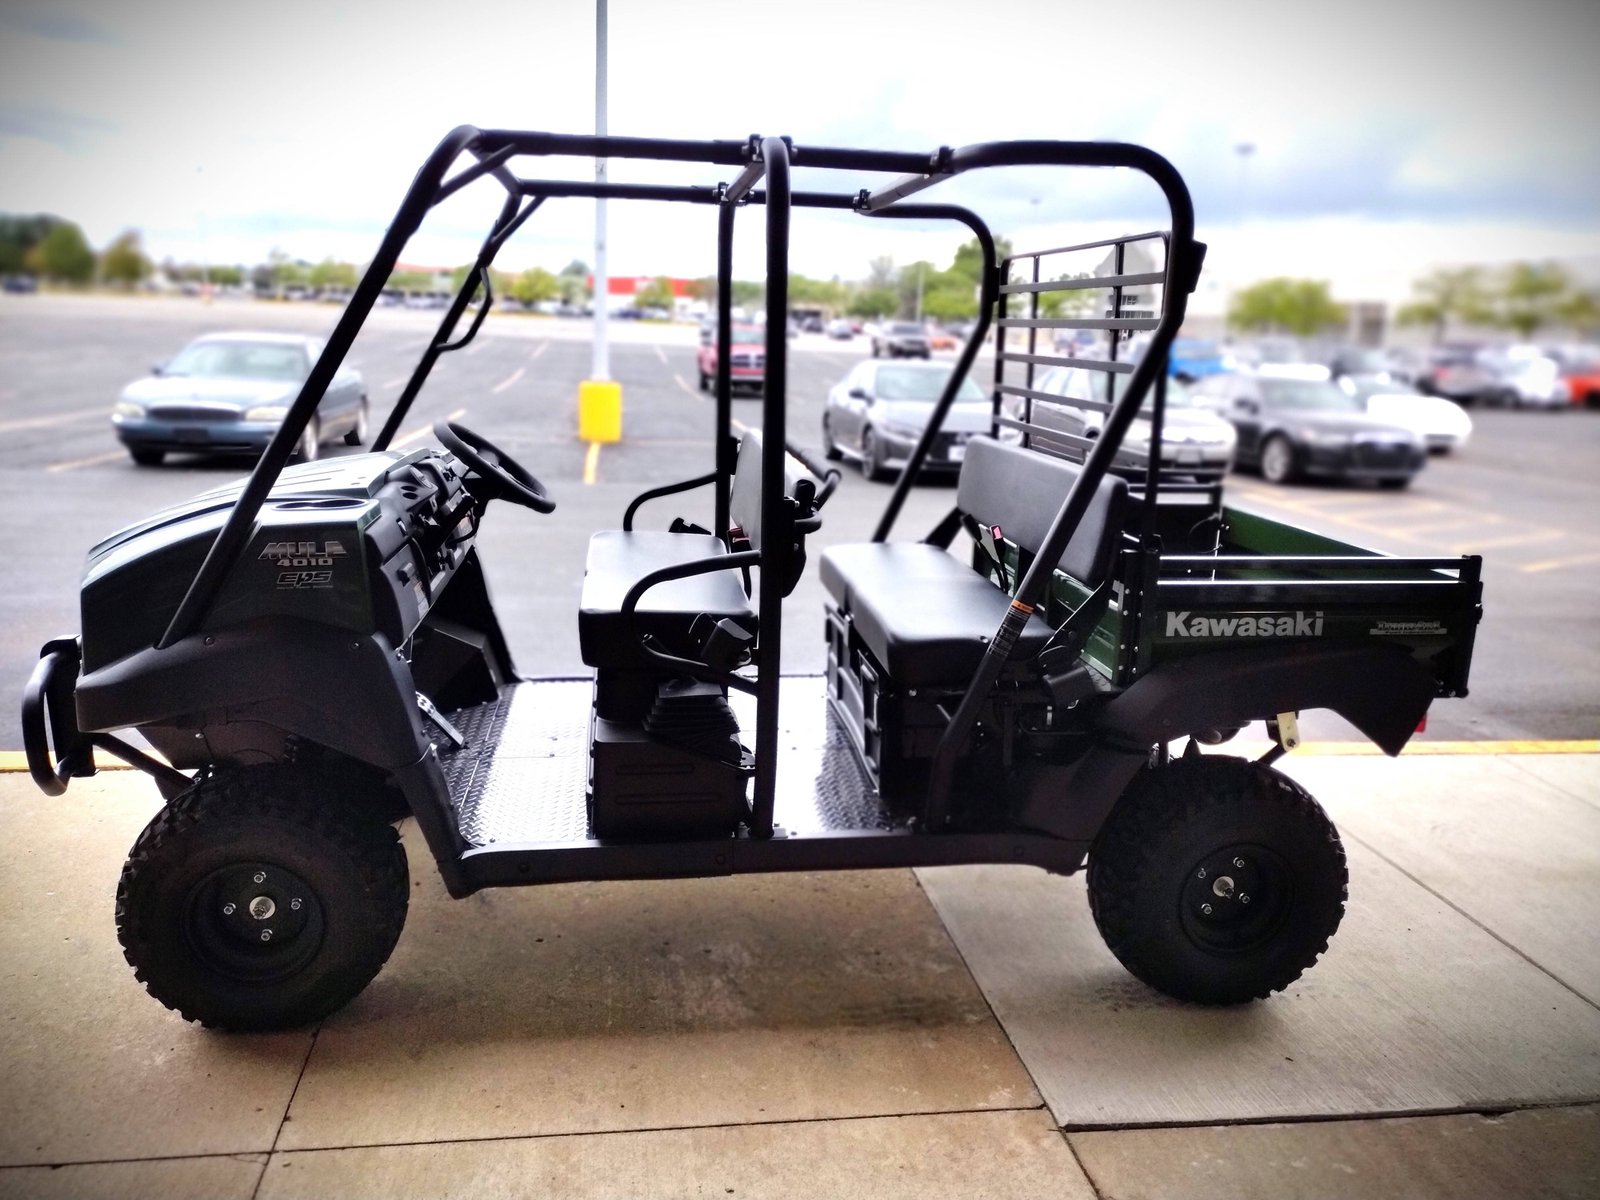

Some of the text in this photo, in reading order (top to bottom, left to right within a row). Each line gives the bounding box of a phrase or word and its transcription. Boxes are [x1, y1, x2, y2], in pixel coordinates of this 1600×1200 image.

[258, 541, 348, 559] MULE
[277, 558, 333, 566] 4010
[1166, 611, 1324, 637] Kawasaki
